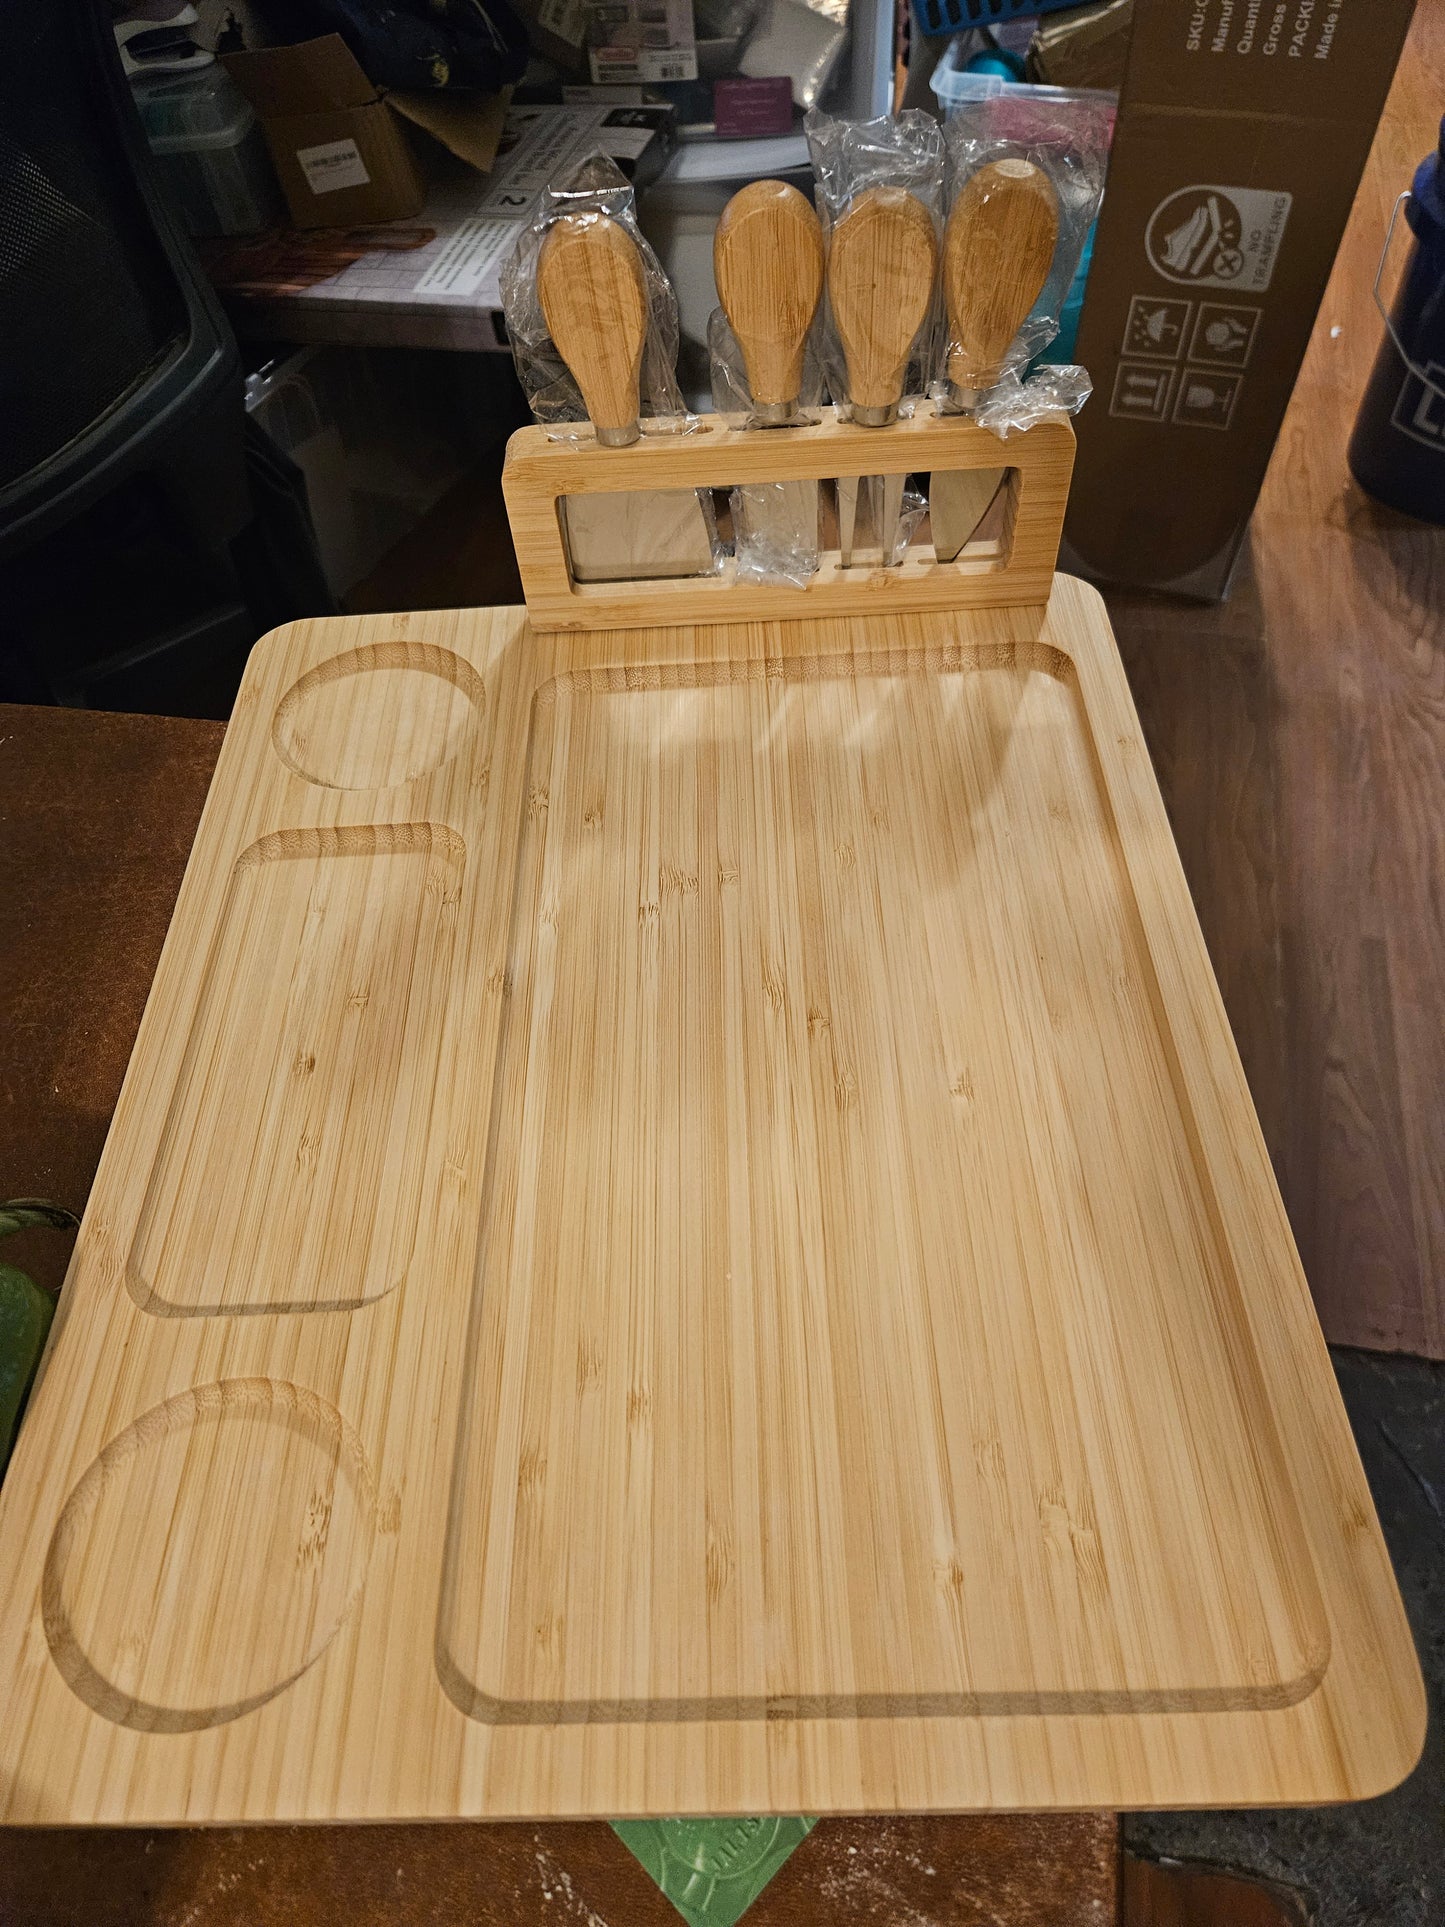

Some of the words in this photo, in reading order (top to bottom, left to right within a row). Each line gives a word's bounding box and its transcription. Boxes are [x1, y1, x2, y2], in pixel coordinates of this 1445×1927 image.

[1262, 4, 1287, 56] Gross
[1313, 13, 1339, 60] Made
[1247, 228, 1263, 253] NO
